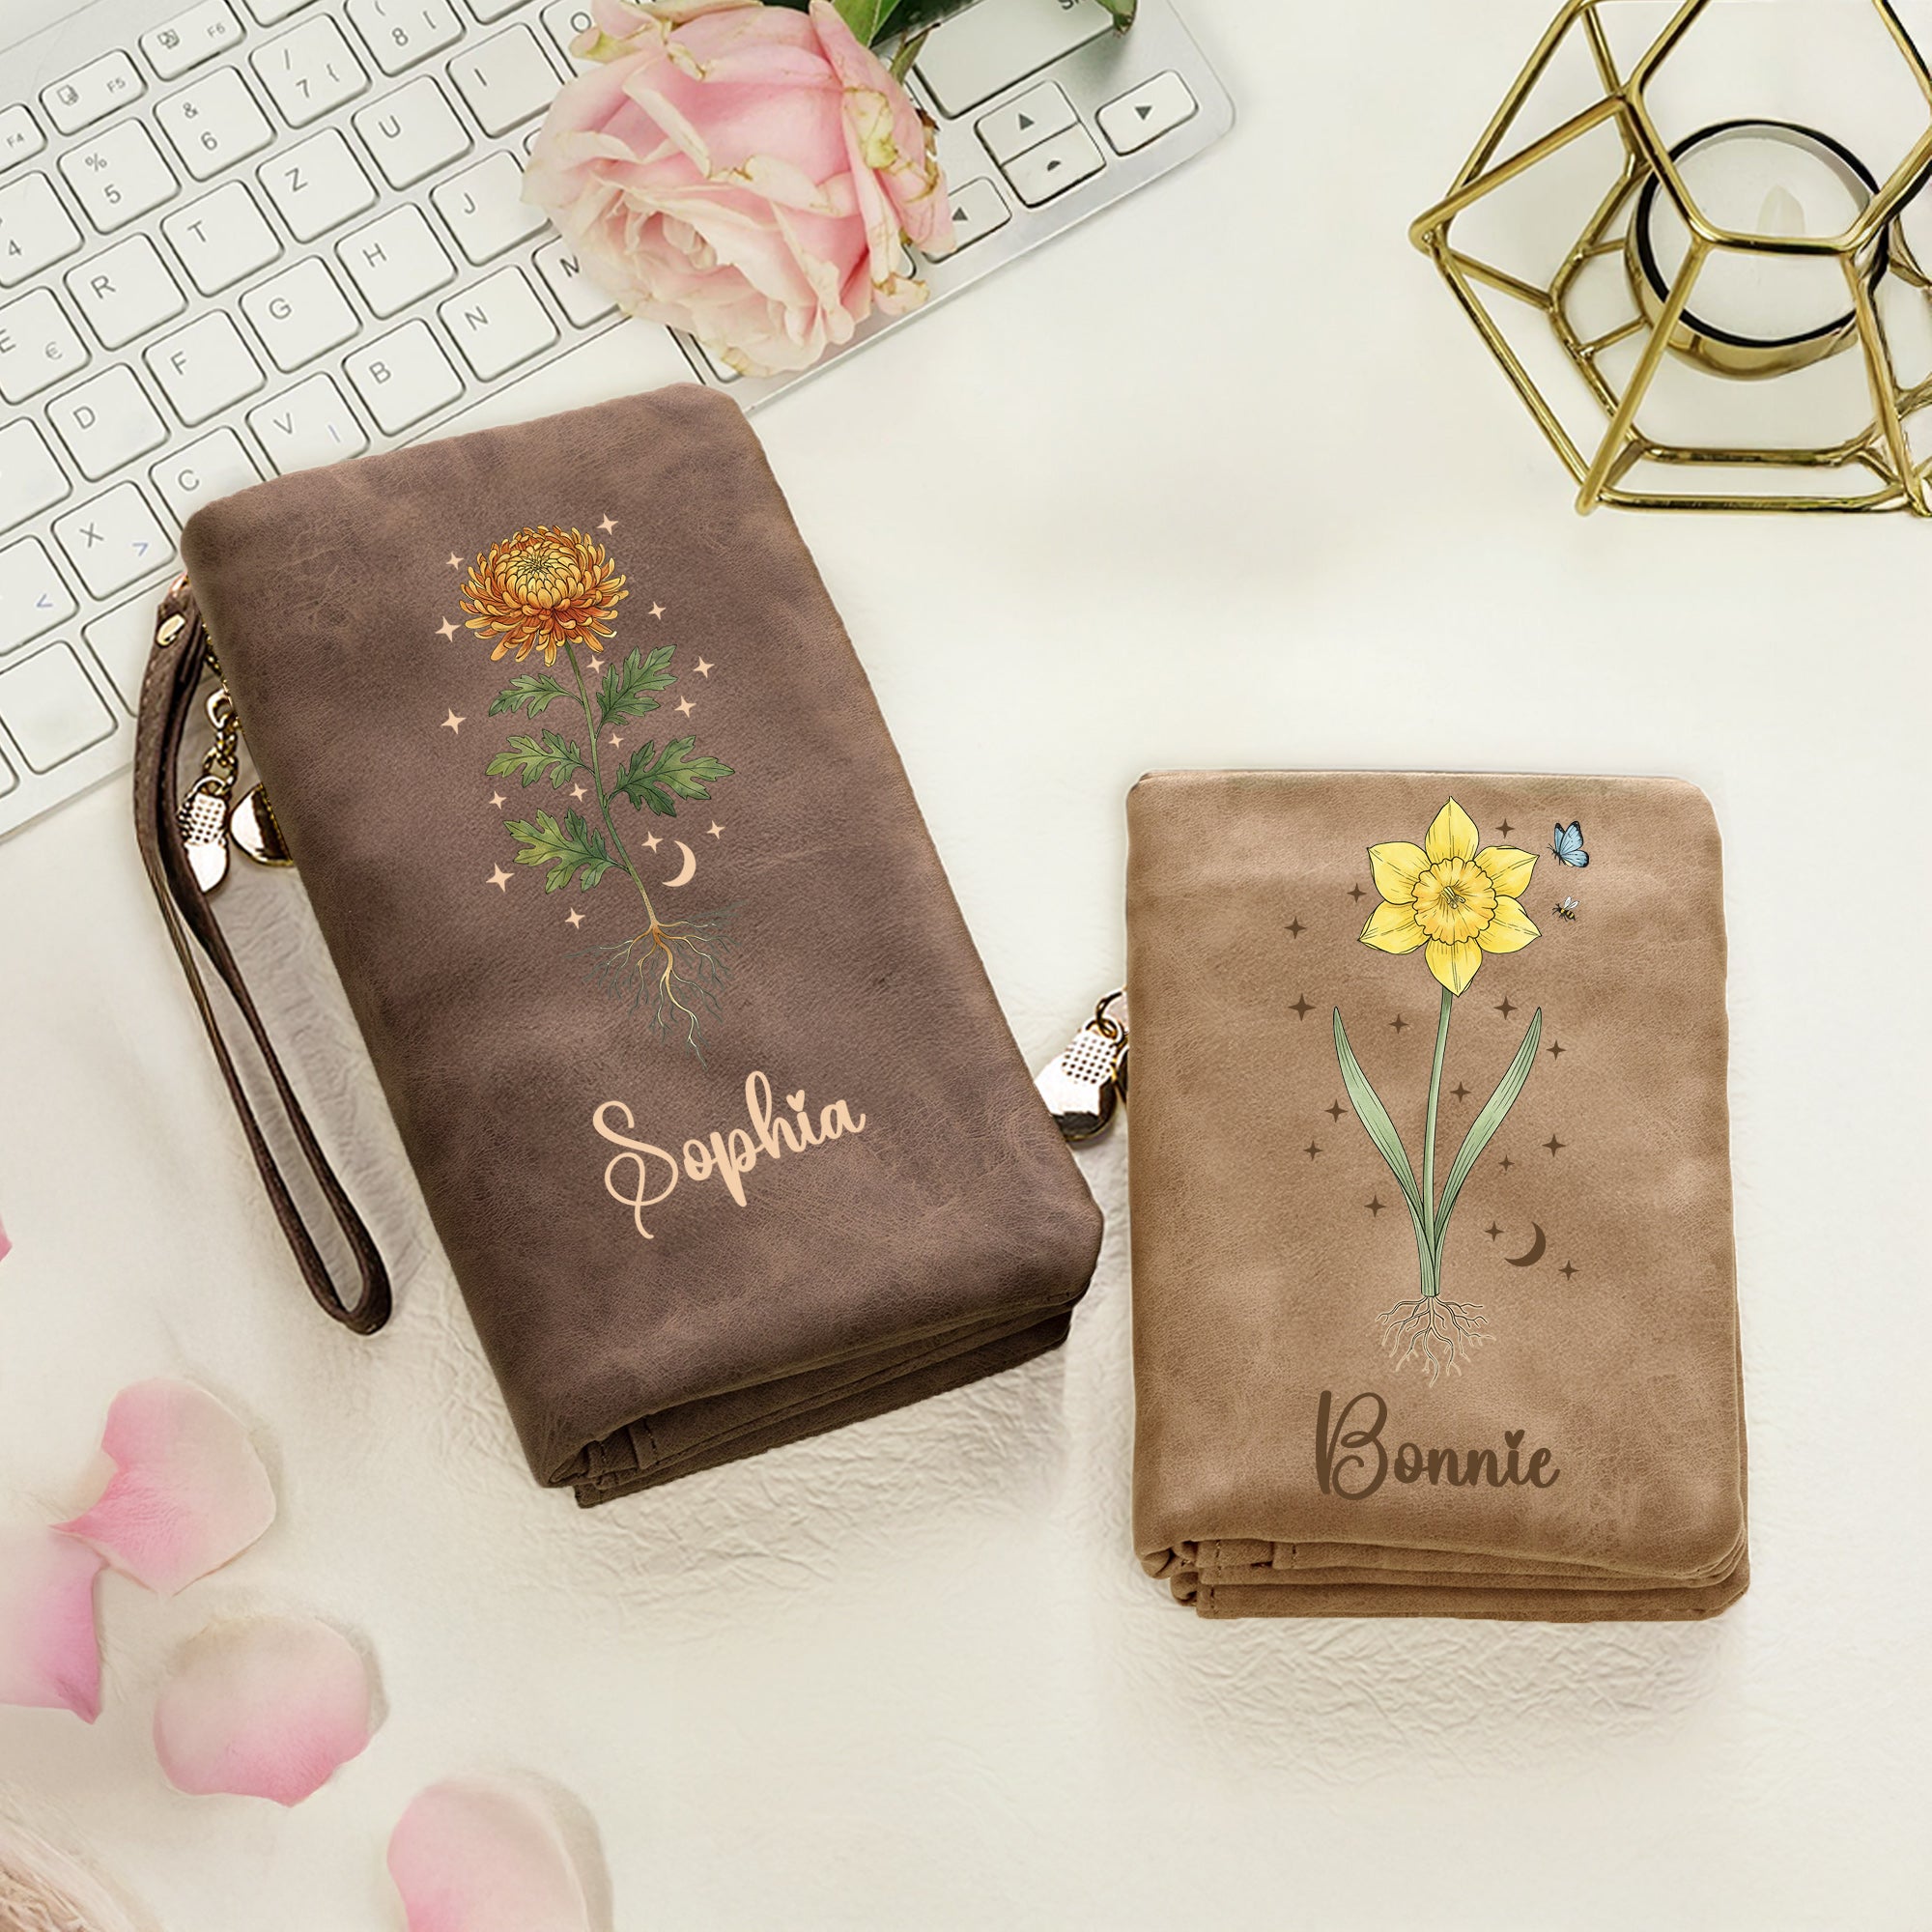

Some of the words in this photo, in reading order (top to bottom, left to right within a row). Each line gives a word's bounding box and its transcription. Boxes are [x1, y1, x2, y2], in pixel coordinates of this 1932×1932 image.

[207, 23, 225, 37] F6
[571, 12, 591, 33] O
[392, 28, 409, 46] 8
[107, 78, 126, 93] F5
[297, 79, 309, 98] 7
[184, 103, 198, 118] &
[379, 116, 400, 138] U
[7, 133, 23, 147] F4
[201, 132, 217, 150] 6
[85, 154, 107, 171] %
[285, 168, 307, 191] Z
[104, 185, 121, 203] 5
[465, 193, 475, 213] J
[187, 220, 206, 242] T
[10, 241, 20, 255] 4
[363, 243, 386, 267] H
[91, 276, 115, 298] R
[270, 298, 292, 319] G
[465, 306, 488, 330] N
[0, 329, 15, 354] E
[171, 352, 185, 375] F
[369, 362, 390, 384] B
[73, 407, 95, 429] D
[273, 413, 292, 434] V
[178, 469, 199, 491] C
[80, 524, 103, 548] X
[593, 1071, 866, 1238] Sophia
[1316, 1391, 1559, 1500] Bonnie
